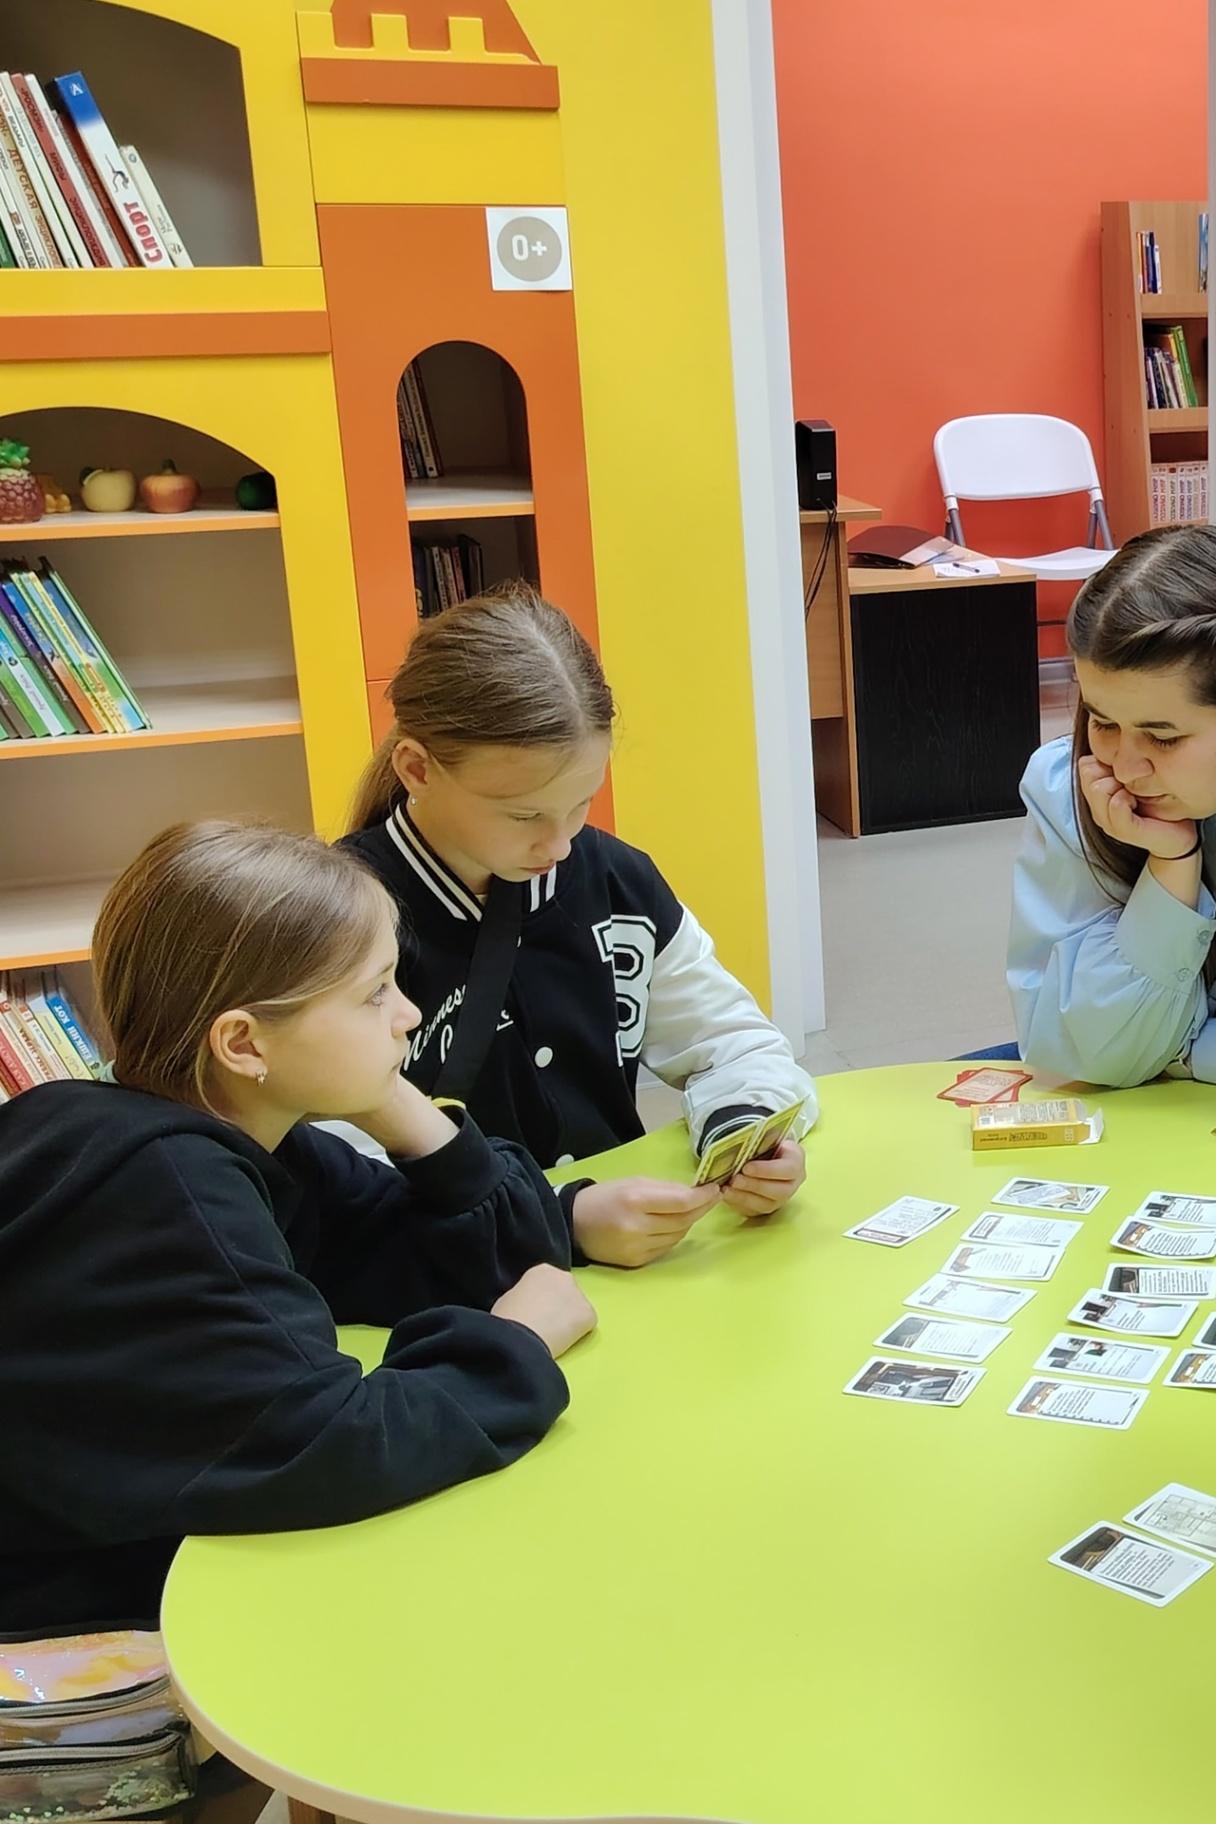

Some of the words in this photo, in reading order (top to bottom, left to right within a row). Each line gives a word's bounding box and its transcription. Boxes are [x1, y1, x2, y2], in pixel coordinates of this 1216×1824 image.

[123, 201, 163, 264] Спорт
[511, 234, 547, 261] 0+
[53, 1004, 70, 1025] КОТ
